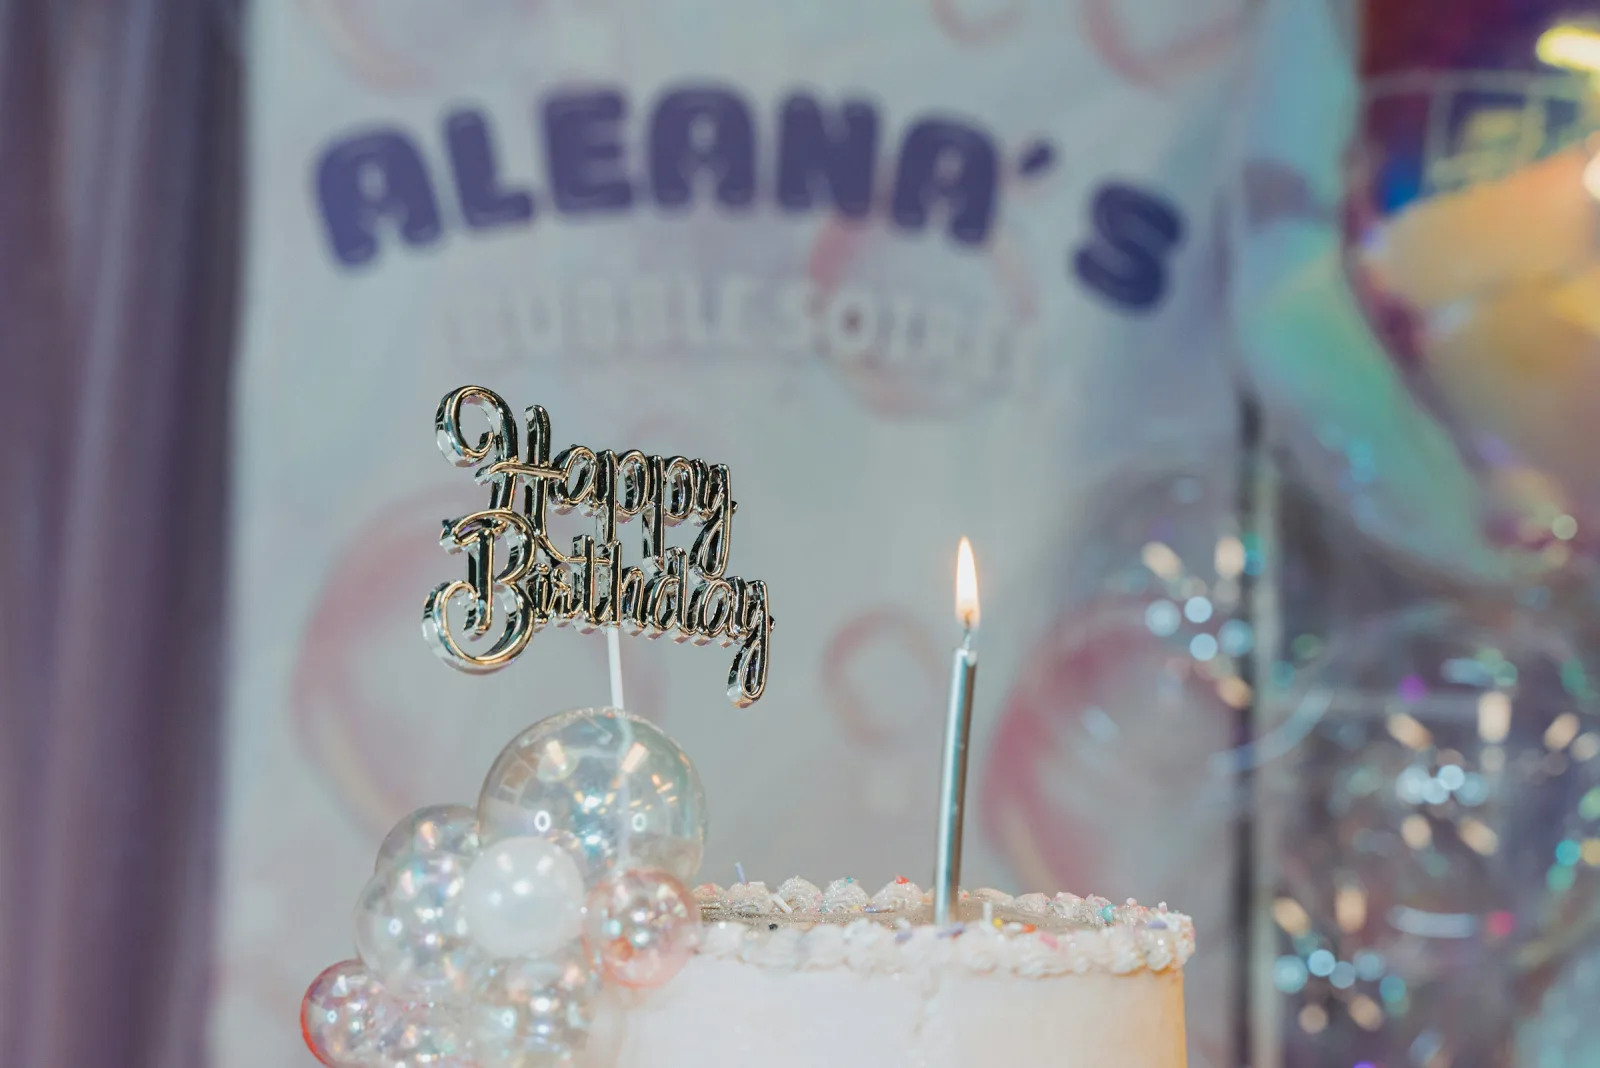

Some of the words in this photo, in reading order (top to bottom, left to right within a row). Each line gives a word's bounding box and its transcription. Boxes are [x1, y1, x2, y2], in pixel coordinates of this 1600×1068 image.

[313, 83, 1187, 312] ALEANA'S
[435, 385, 737, 580] Happy
[421, 509, 775, 708] Birthday
